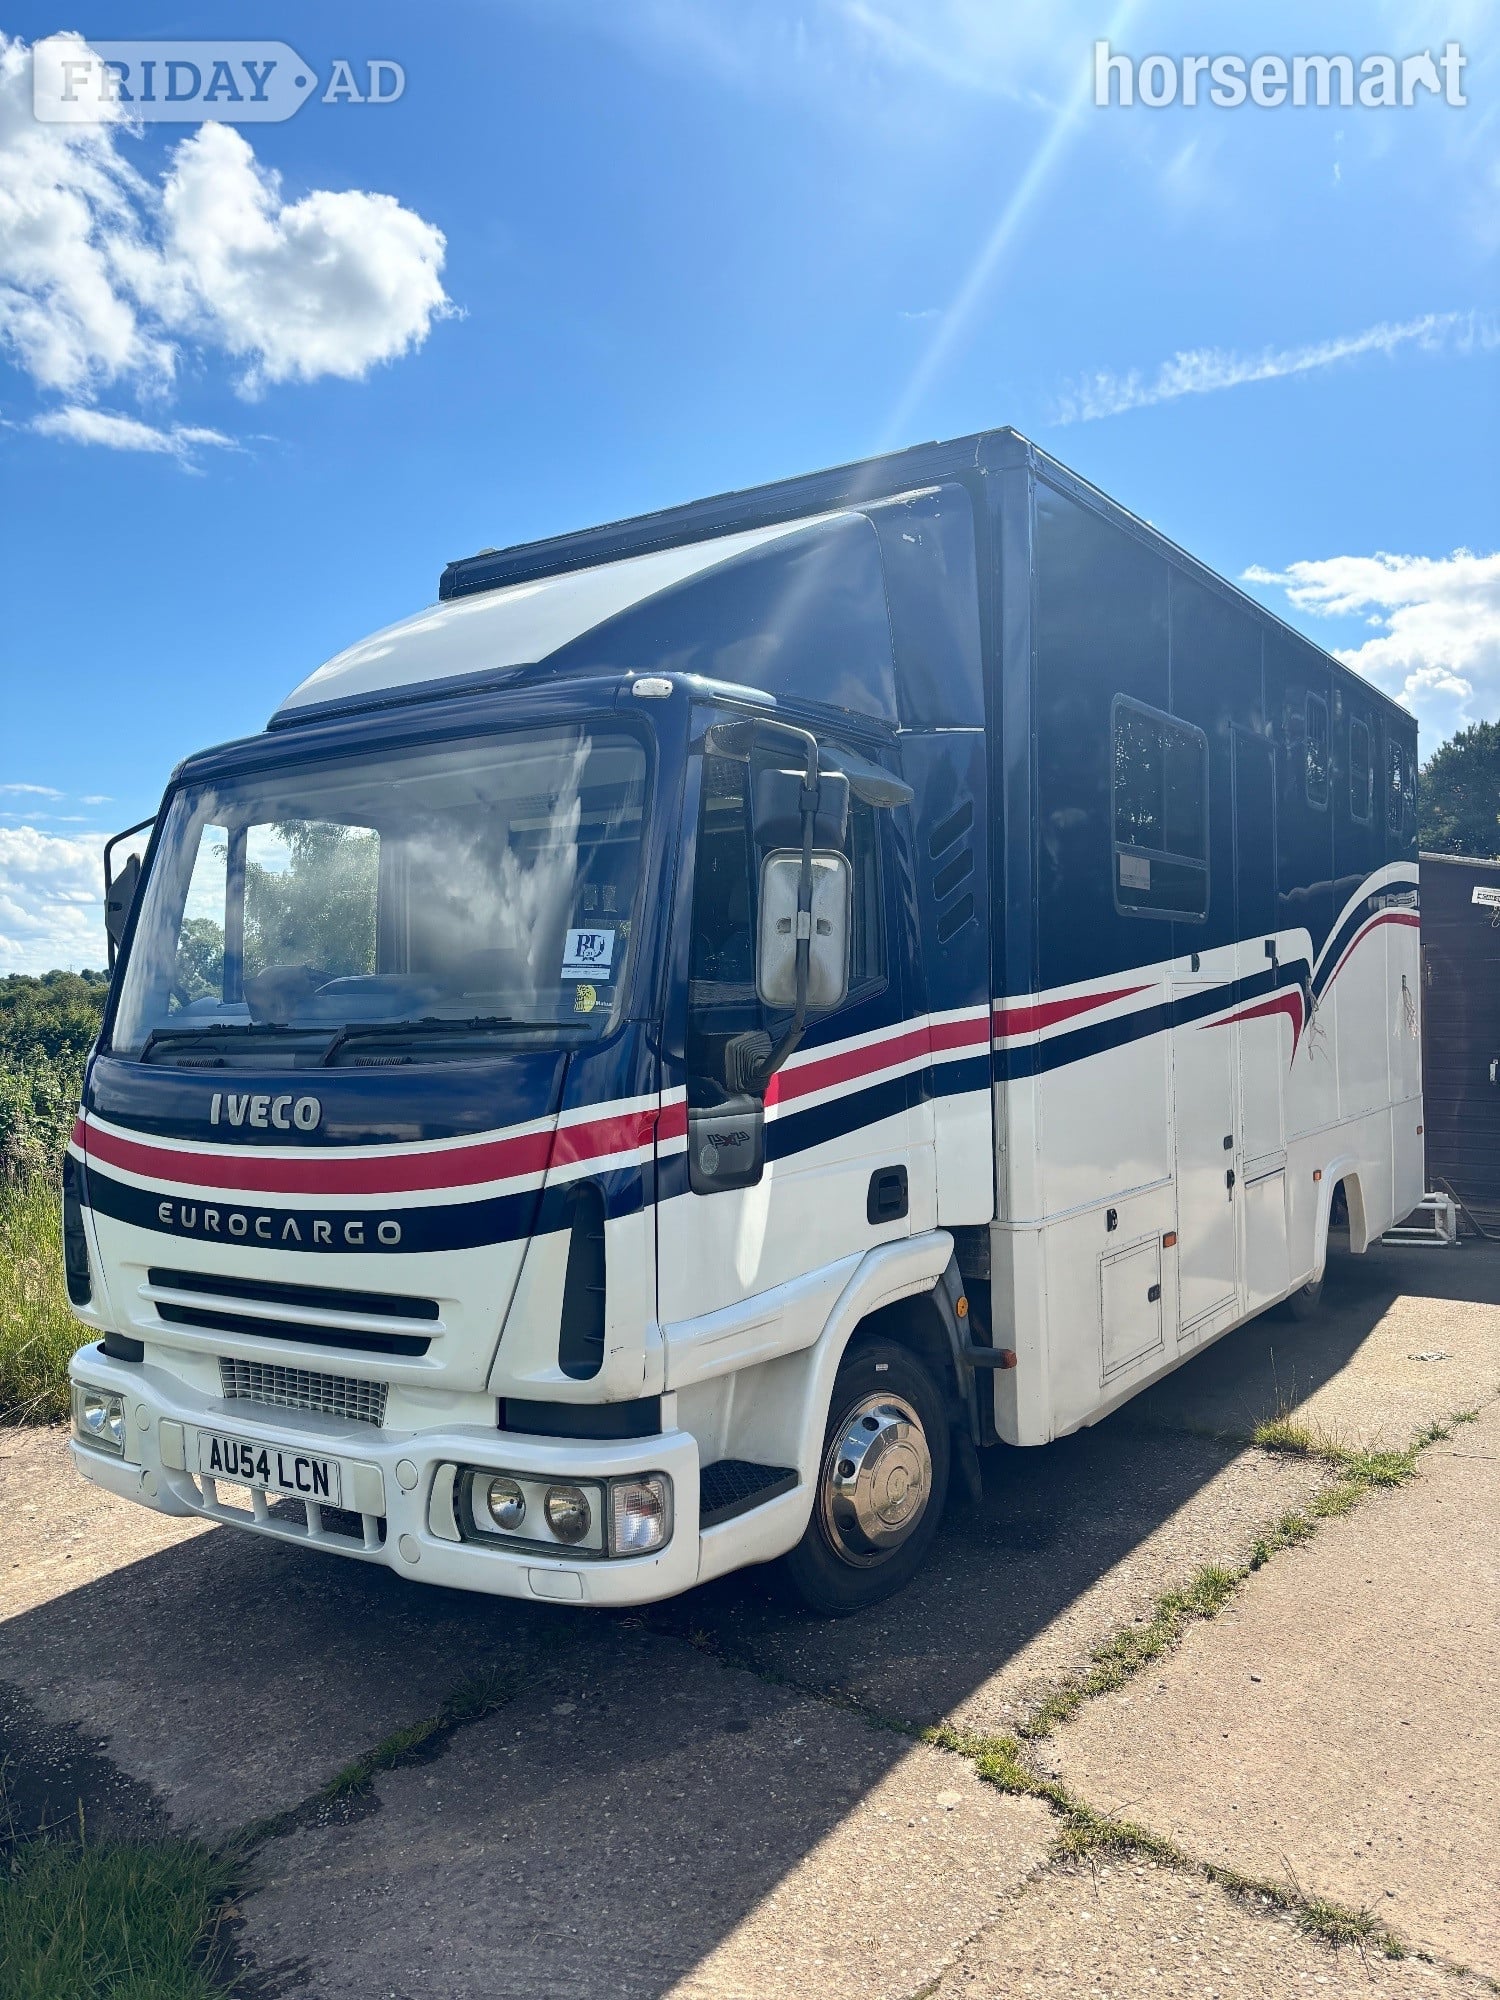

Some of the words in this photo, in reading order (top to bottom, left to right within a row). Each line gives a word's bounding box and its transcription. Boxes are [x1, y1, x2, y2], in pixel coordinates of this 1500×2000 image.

[210, 1093, 321, 1131] IVECO
[157, 1202, 402, 1245] EUROCARGO
[210, 1437, 271, 1483] AU54
[277, 1453, 330, 1497] LCN
